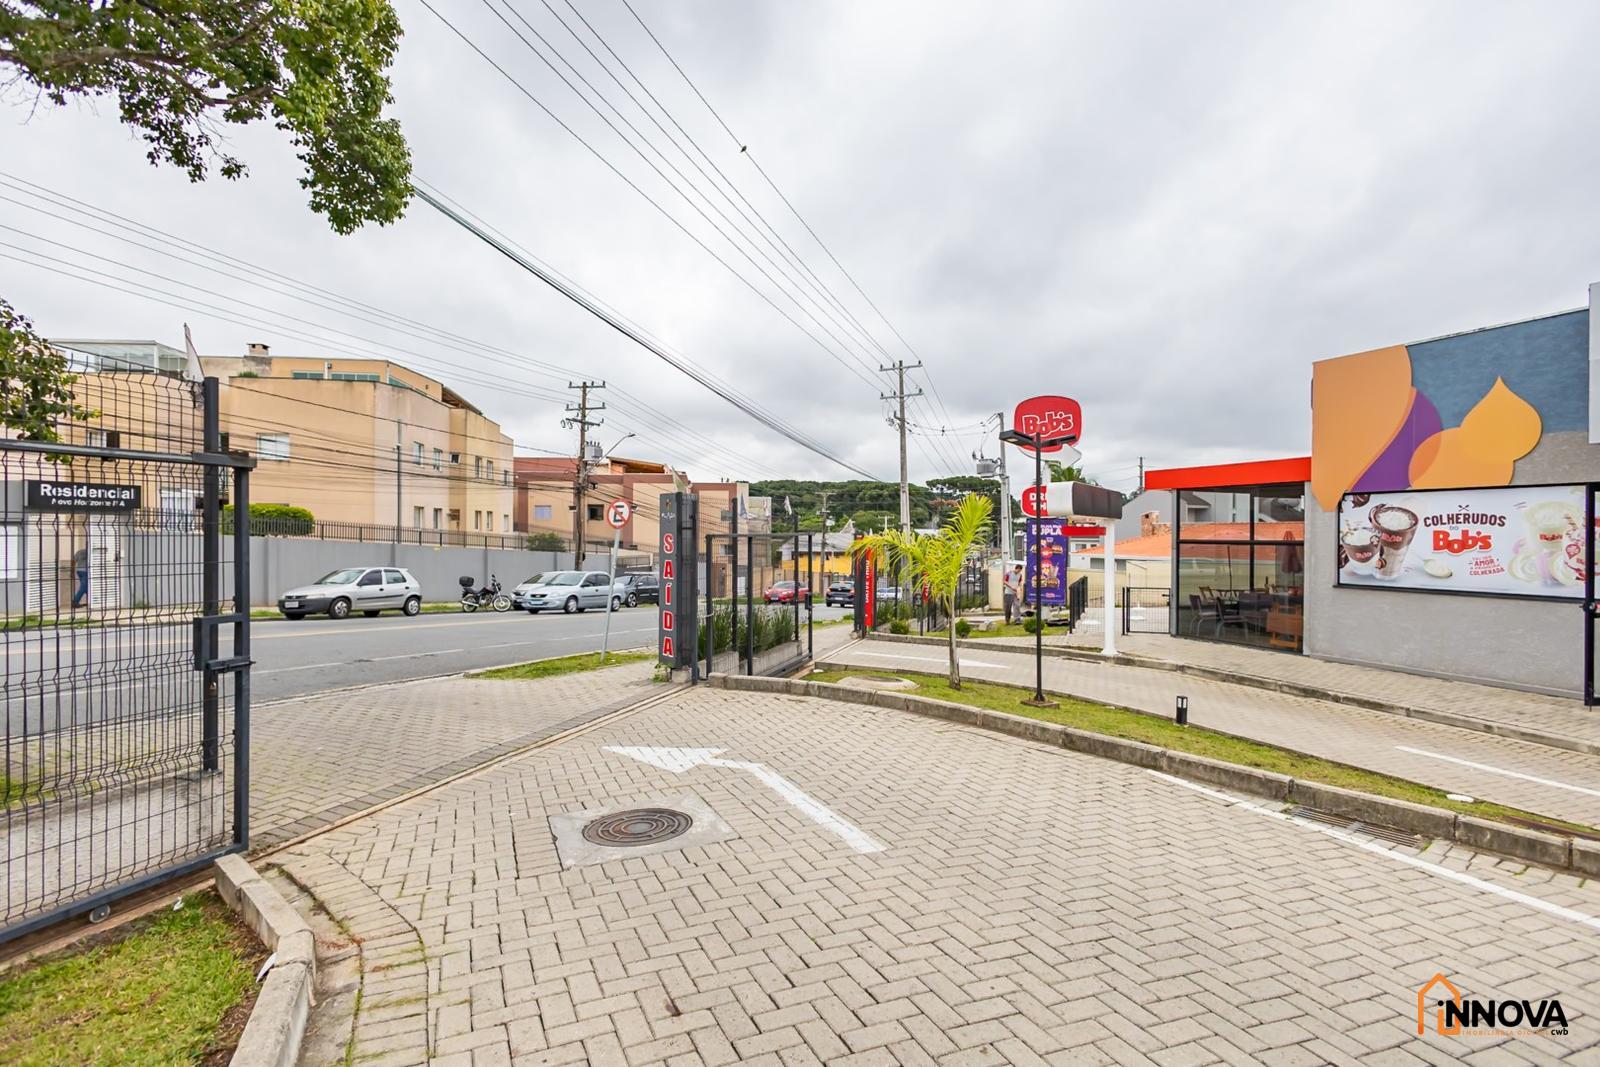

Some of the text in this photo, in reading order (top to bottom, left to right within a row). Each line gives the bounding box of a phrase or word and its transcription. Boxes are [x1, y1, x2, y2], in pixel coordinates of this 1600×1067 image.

[1022, 411, 1074, 437] Bob's
[40, 483, 135, 500] Residencial
[1423, 512, 1507, 528] COLHERUDOS
[1432, 529, 1492, 554] Bob's
[663, 533, 674, 658] SAÍDA
